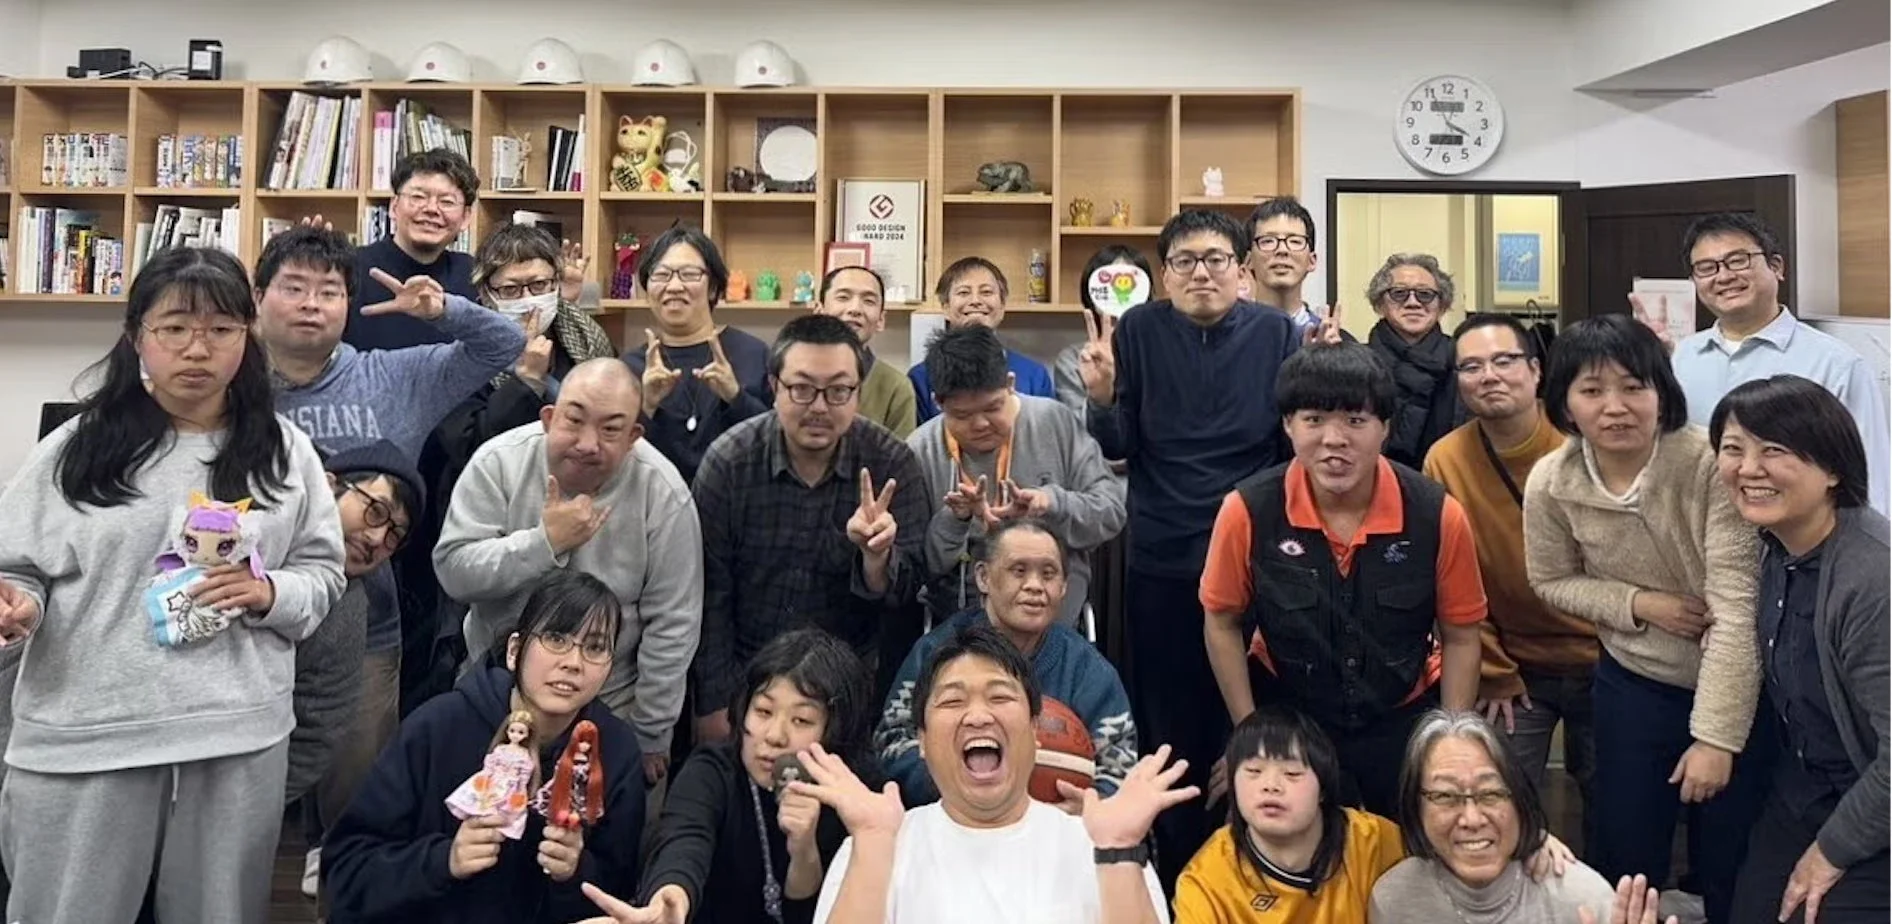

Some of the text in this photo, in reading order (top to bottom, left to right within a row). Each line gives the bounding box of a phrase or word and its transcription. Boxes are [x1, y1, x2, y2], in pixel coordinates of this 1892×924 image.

[1424, 88, 1435, 99] 11
[1441, 83, 1455, 95] 12
[1463, 88, 1469, 99] 1
[1411, 100, 1423, 112] 10
[1475, 101, 1484, 112] 2
[1406, 117, 1415, 128] 9
[1480, 118, 1489, 130] 3
[1411, 134, 1420, 146] 8
[1474, 136, 1482, 147] 4
[1424, 147, 1433, 158] 7
[1441, 152, 1451, 163] 6
[1461, 148, 1469, 160] 5
